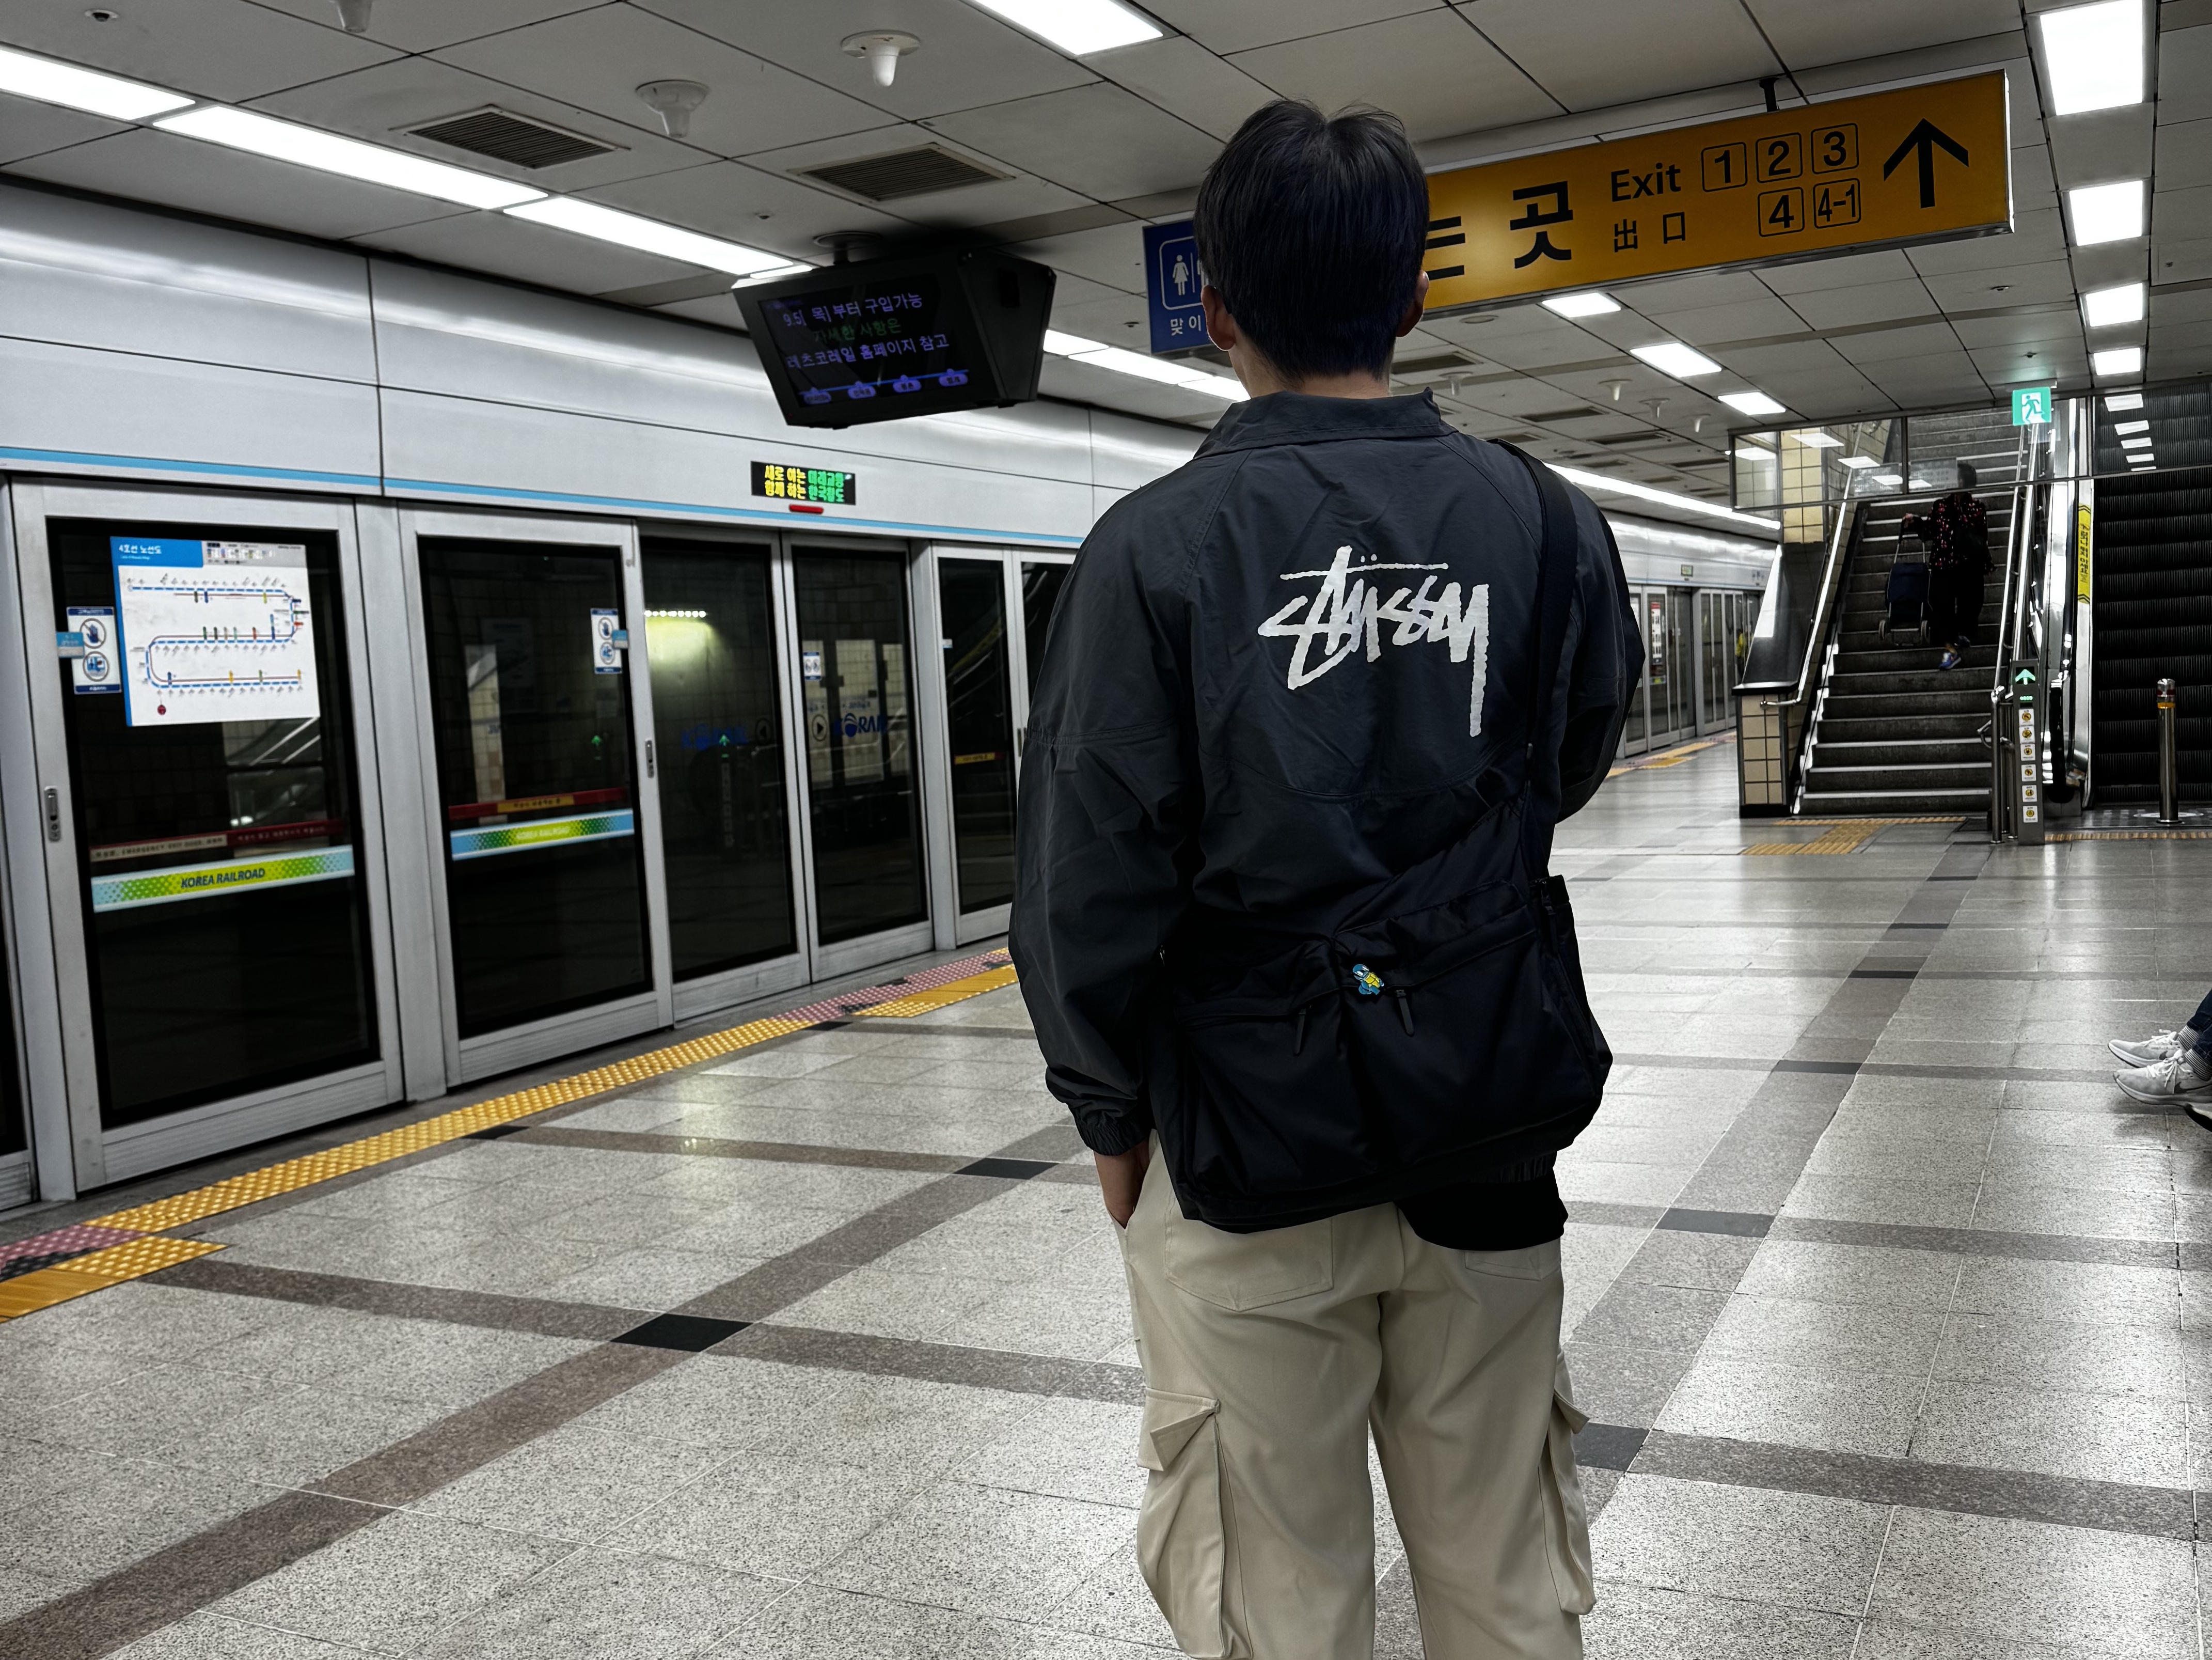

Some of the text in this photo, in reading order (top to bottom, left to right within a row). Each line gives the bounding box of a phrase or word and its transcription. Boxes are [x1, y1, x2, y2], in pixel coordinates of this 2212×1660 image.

[1610, 131, 1846, 202] Exit 1 2 3
[1510, 180, 1573, 269] 곳
[1768, 183, 1856, 229] 4 4-1
[1614, 211, 1686, 253] 出口
[919, 333, 950, 351] 참고
[181, 868, 265, 888] KOREA RAILROAD
